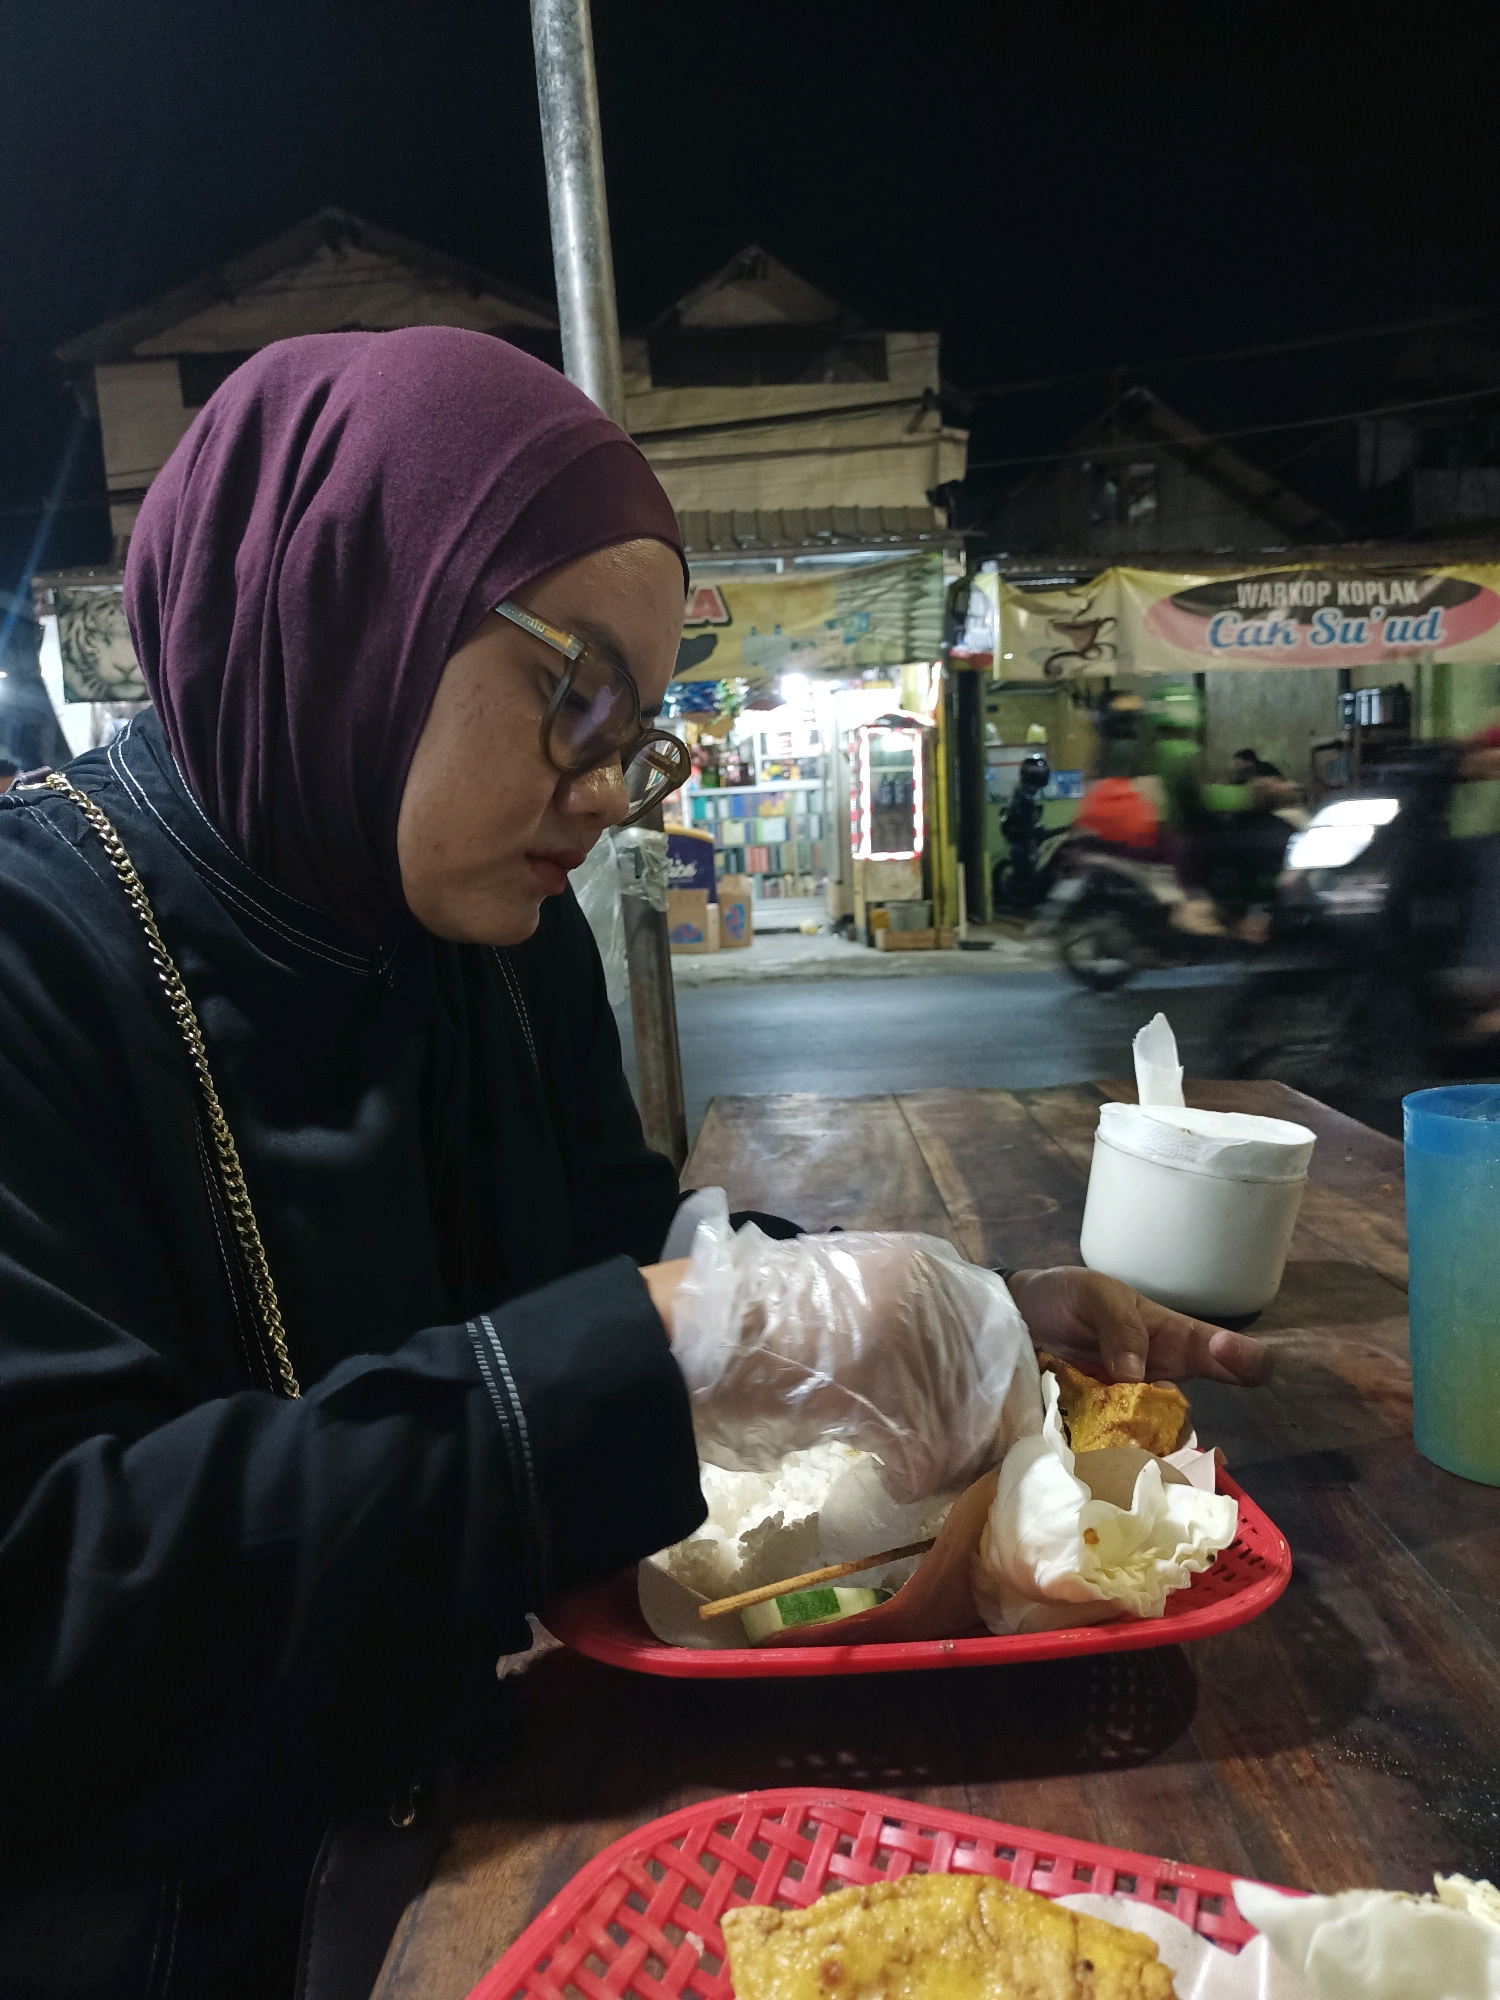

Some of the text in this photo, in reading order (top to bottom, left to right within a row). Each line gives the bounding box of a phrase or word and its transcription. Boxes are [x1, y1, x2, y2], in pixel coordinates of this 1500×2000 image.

[1237, 579, 1420, 609] WARKOP KOPLAK
[1207, 611, 1299, 649] Cak
